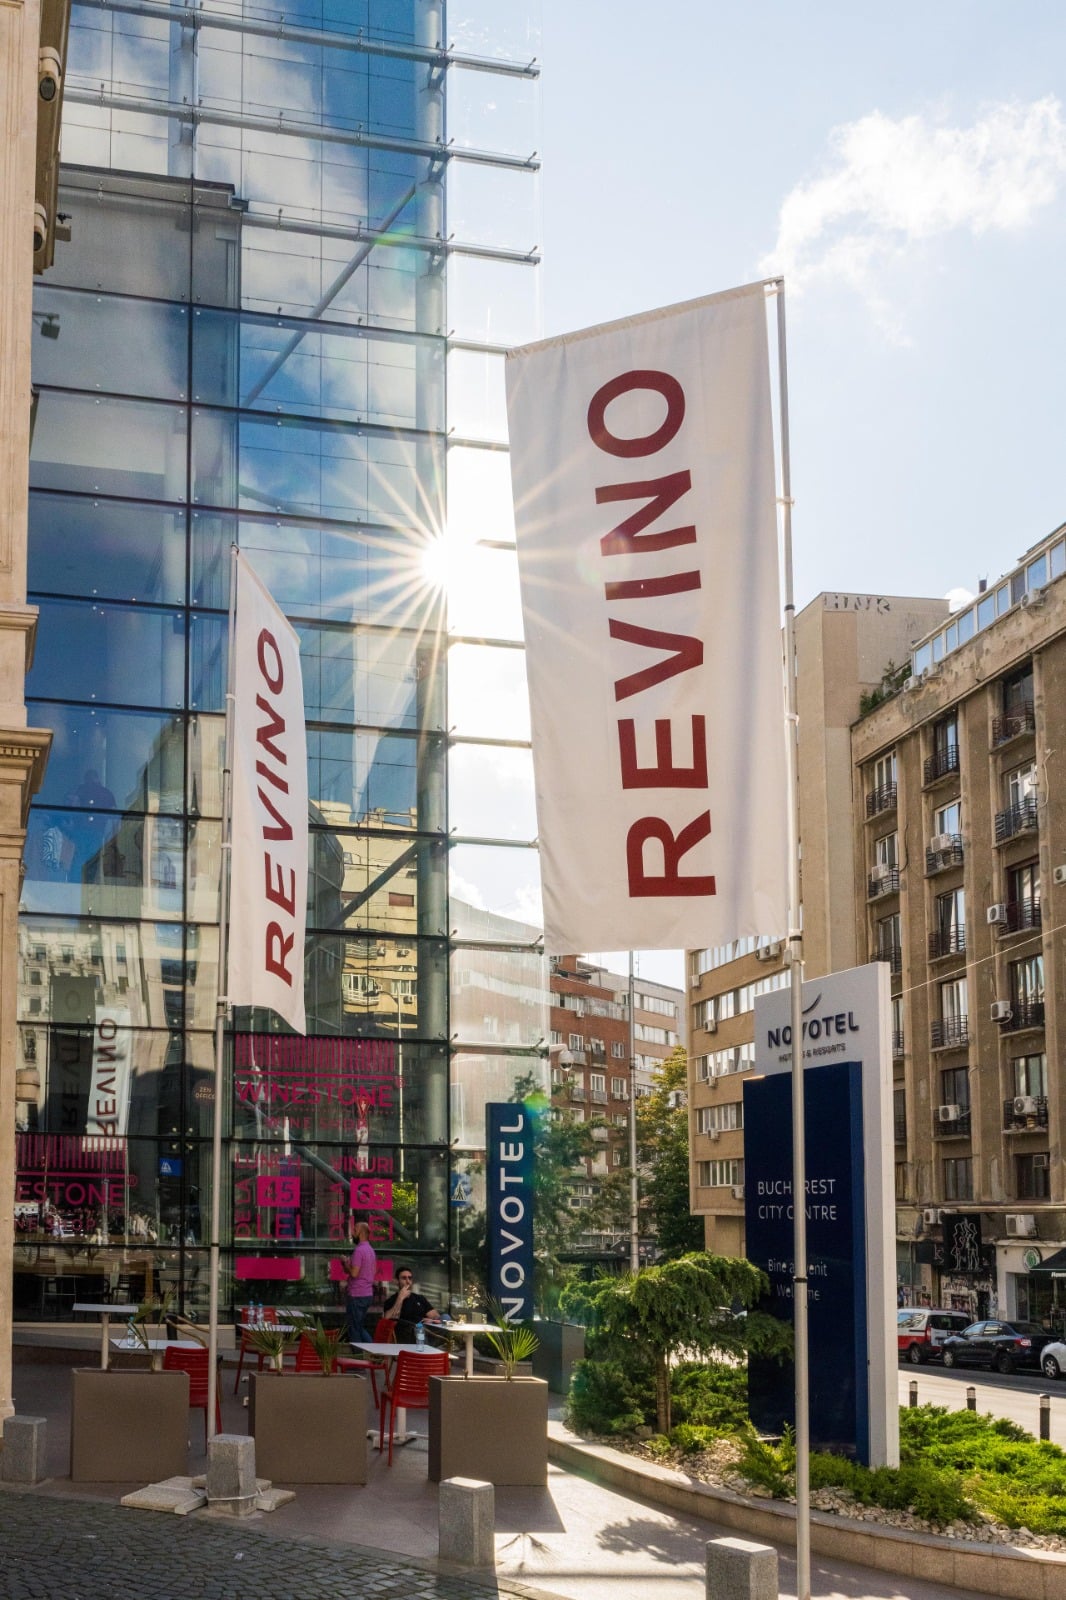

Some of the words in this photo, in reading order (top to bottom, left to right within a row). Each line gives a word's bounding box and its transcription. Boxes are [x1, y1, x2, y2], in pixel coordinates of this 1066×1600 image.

[587, 370, 716, 898] REVINO
[256, 628, 296, 988] REVINO
[813, 1043, 846, 1056] RESORTS
[235, 1080, 393, 1107] WINESTONE
[329, 1156, 393, 1173] VINURI
[264, 1180, 295, 1204] 45
[357, 1183, 386, 1206] 65
[757, 1179, 837, 1195] BUCHREST
[499, 1114, 525, 1324] NOVOTEL
[758, 1205, 784, 1220] CITY
[786, 1205, 837, 1221] CNTRE
[256, 1213, 301, 1239] LEI
[768, 1258, 787, 1273] Bine
